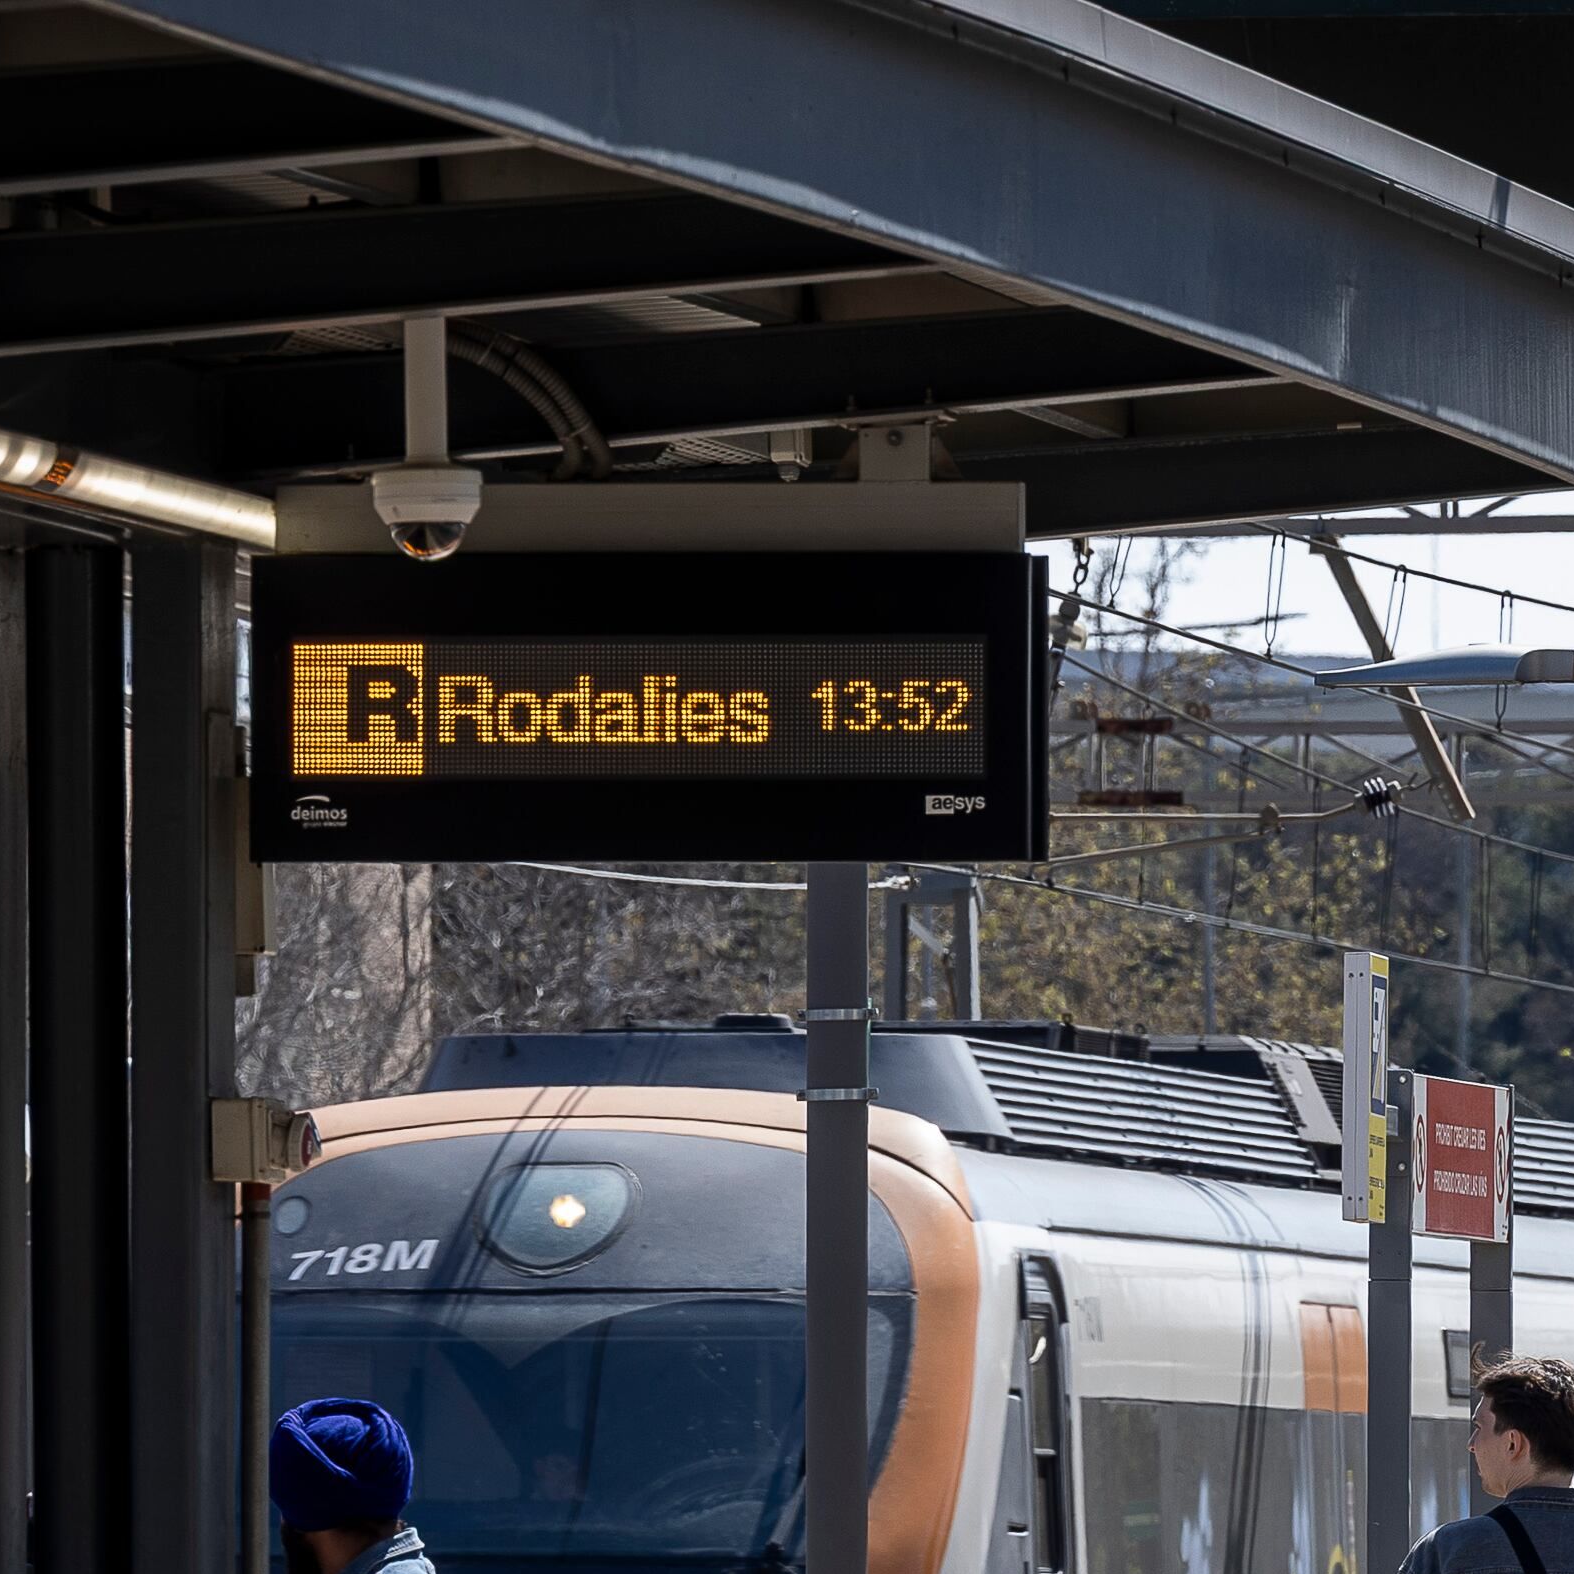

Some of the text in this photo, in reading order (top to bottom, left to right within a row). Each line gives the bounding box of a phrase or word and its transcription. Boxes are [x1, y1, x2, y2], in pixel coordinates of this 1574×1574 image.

[346, 664, 971, 744] R Rodalies 13:52
[291, 806, 347, 820] deimos
[929, 796, 986, 814] aesys
[288, 1239, 440, 1281] 718M
